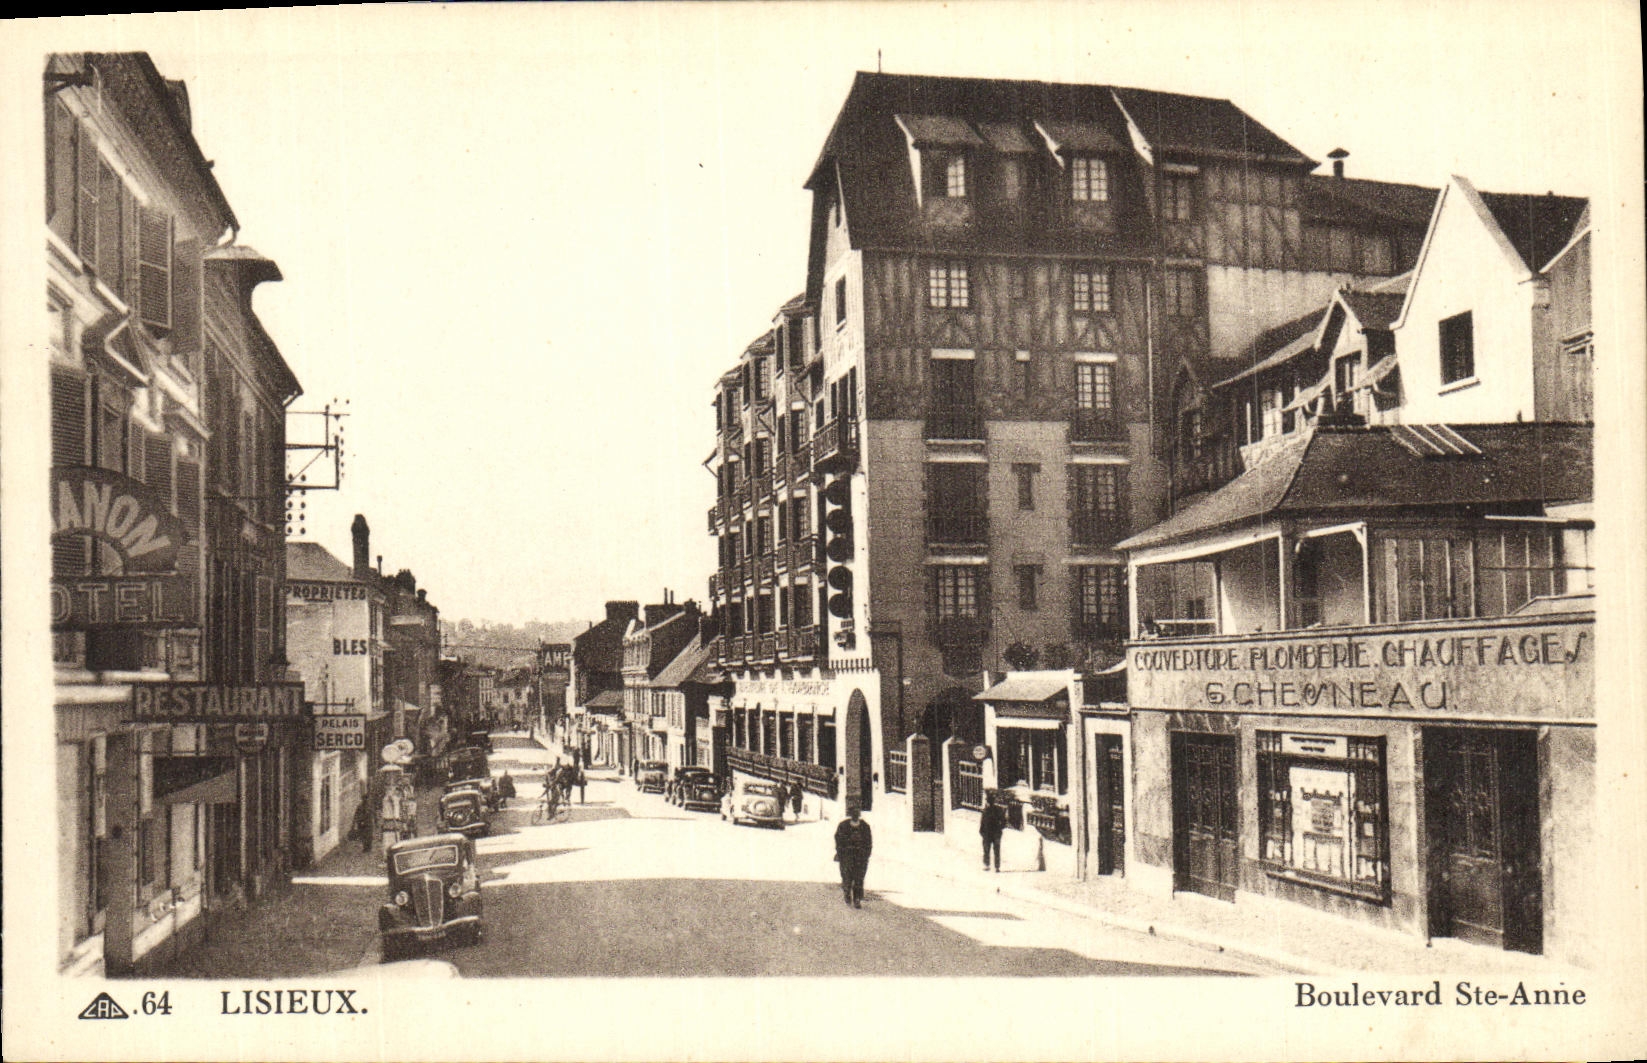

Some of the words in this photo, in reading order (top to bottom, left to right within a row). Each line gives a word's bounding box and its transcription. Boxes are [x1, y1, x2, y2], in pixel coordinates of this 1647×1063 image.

[333, 638, 367, 655] BLES
[135, 686, 303, 716] RESTAURANT
[316, 732, 363, 746] SERCO
